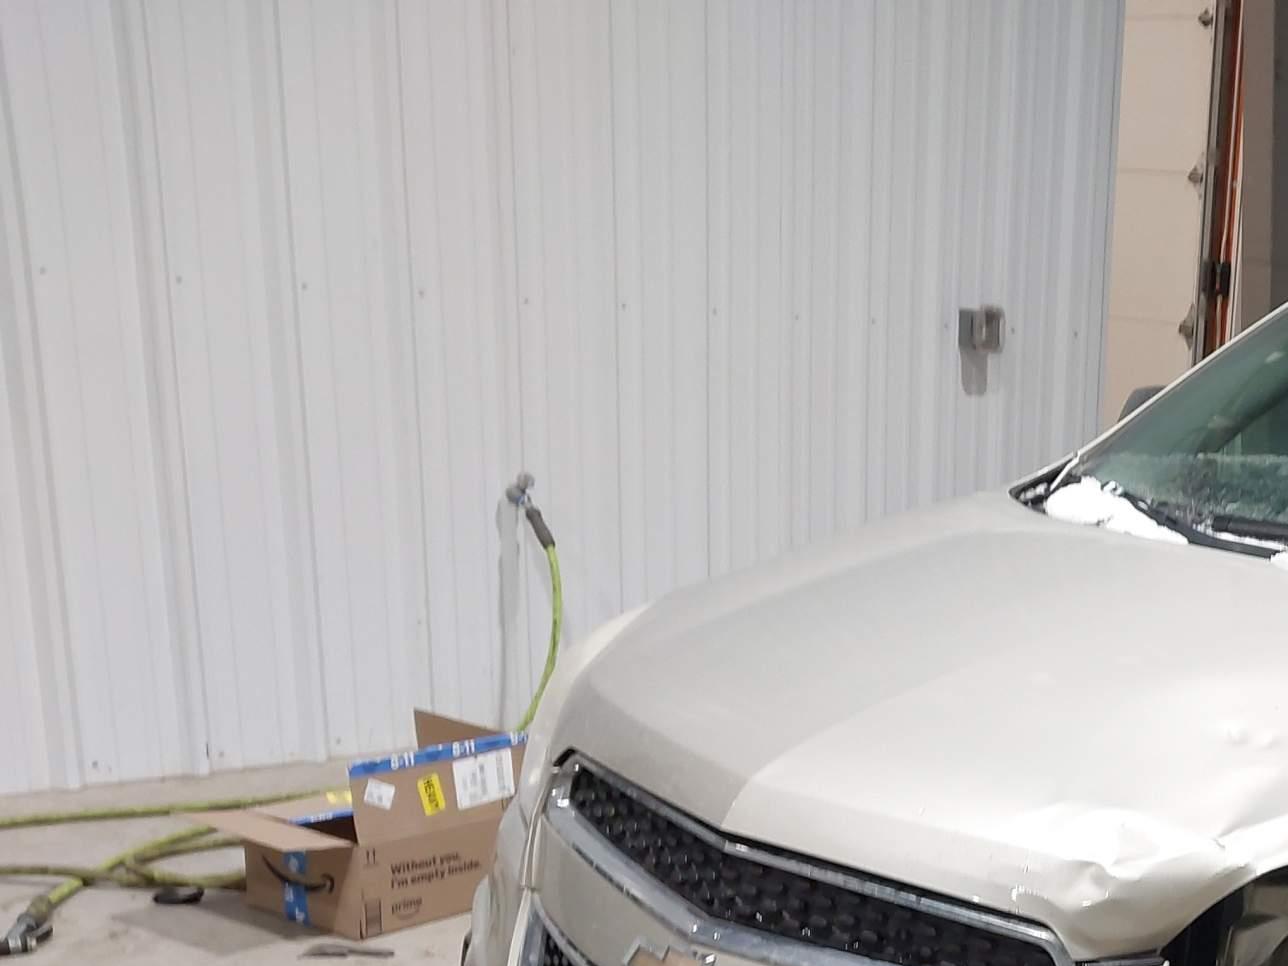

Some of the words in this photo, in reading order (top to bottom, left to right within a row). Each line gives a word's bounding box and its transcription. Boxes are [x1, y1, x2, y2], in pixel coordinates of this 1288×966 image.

[391, 857, 436, 875] Without
[391, 877, 409, 889] I'm
[411, 868, 445, 884] empty
[391, 897, 423, 915] prime
